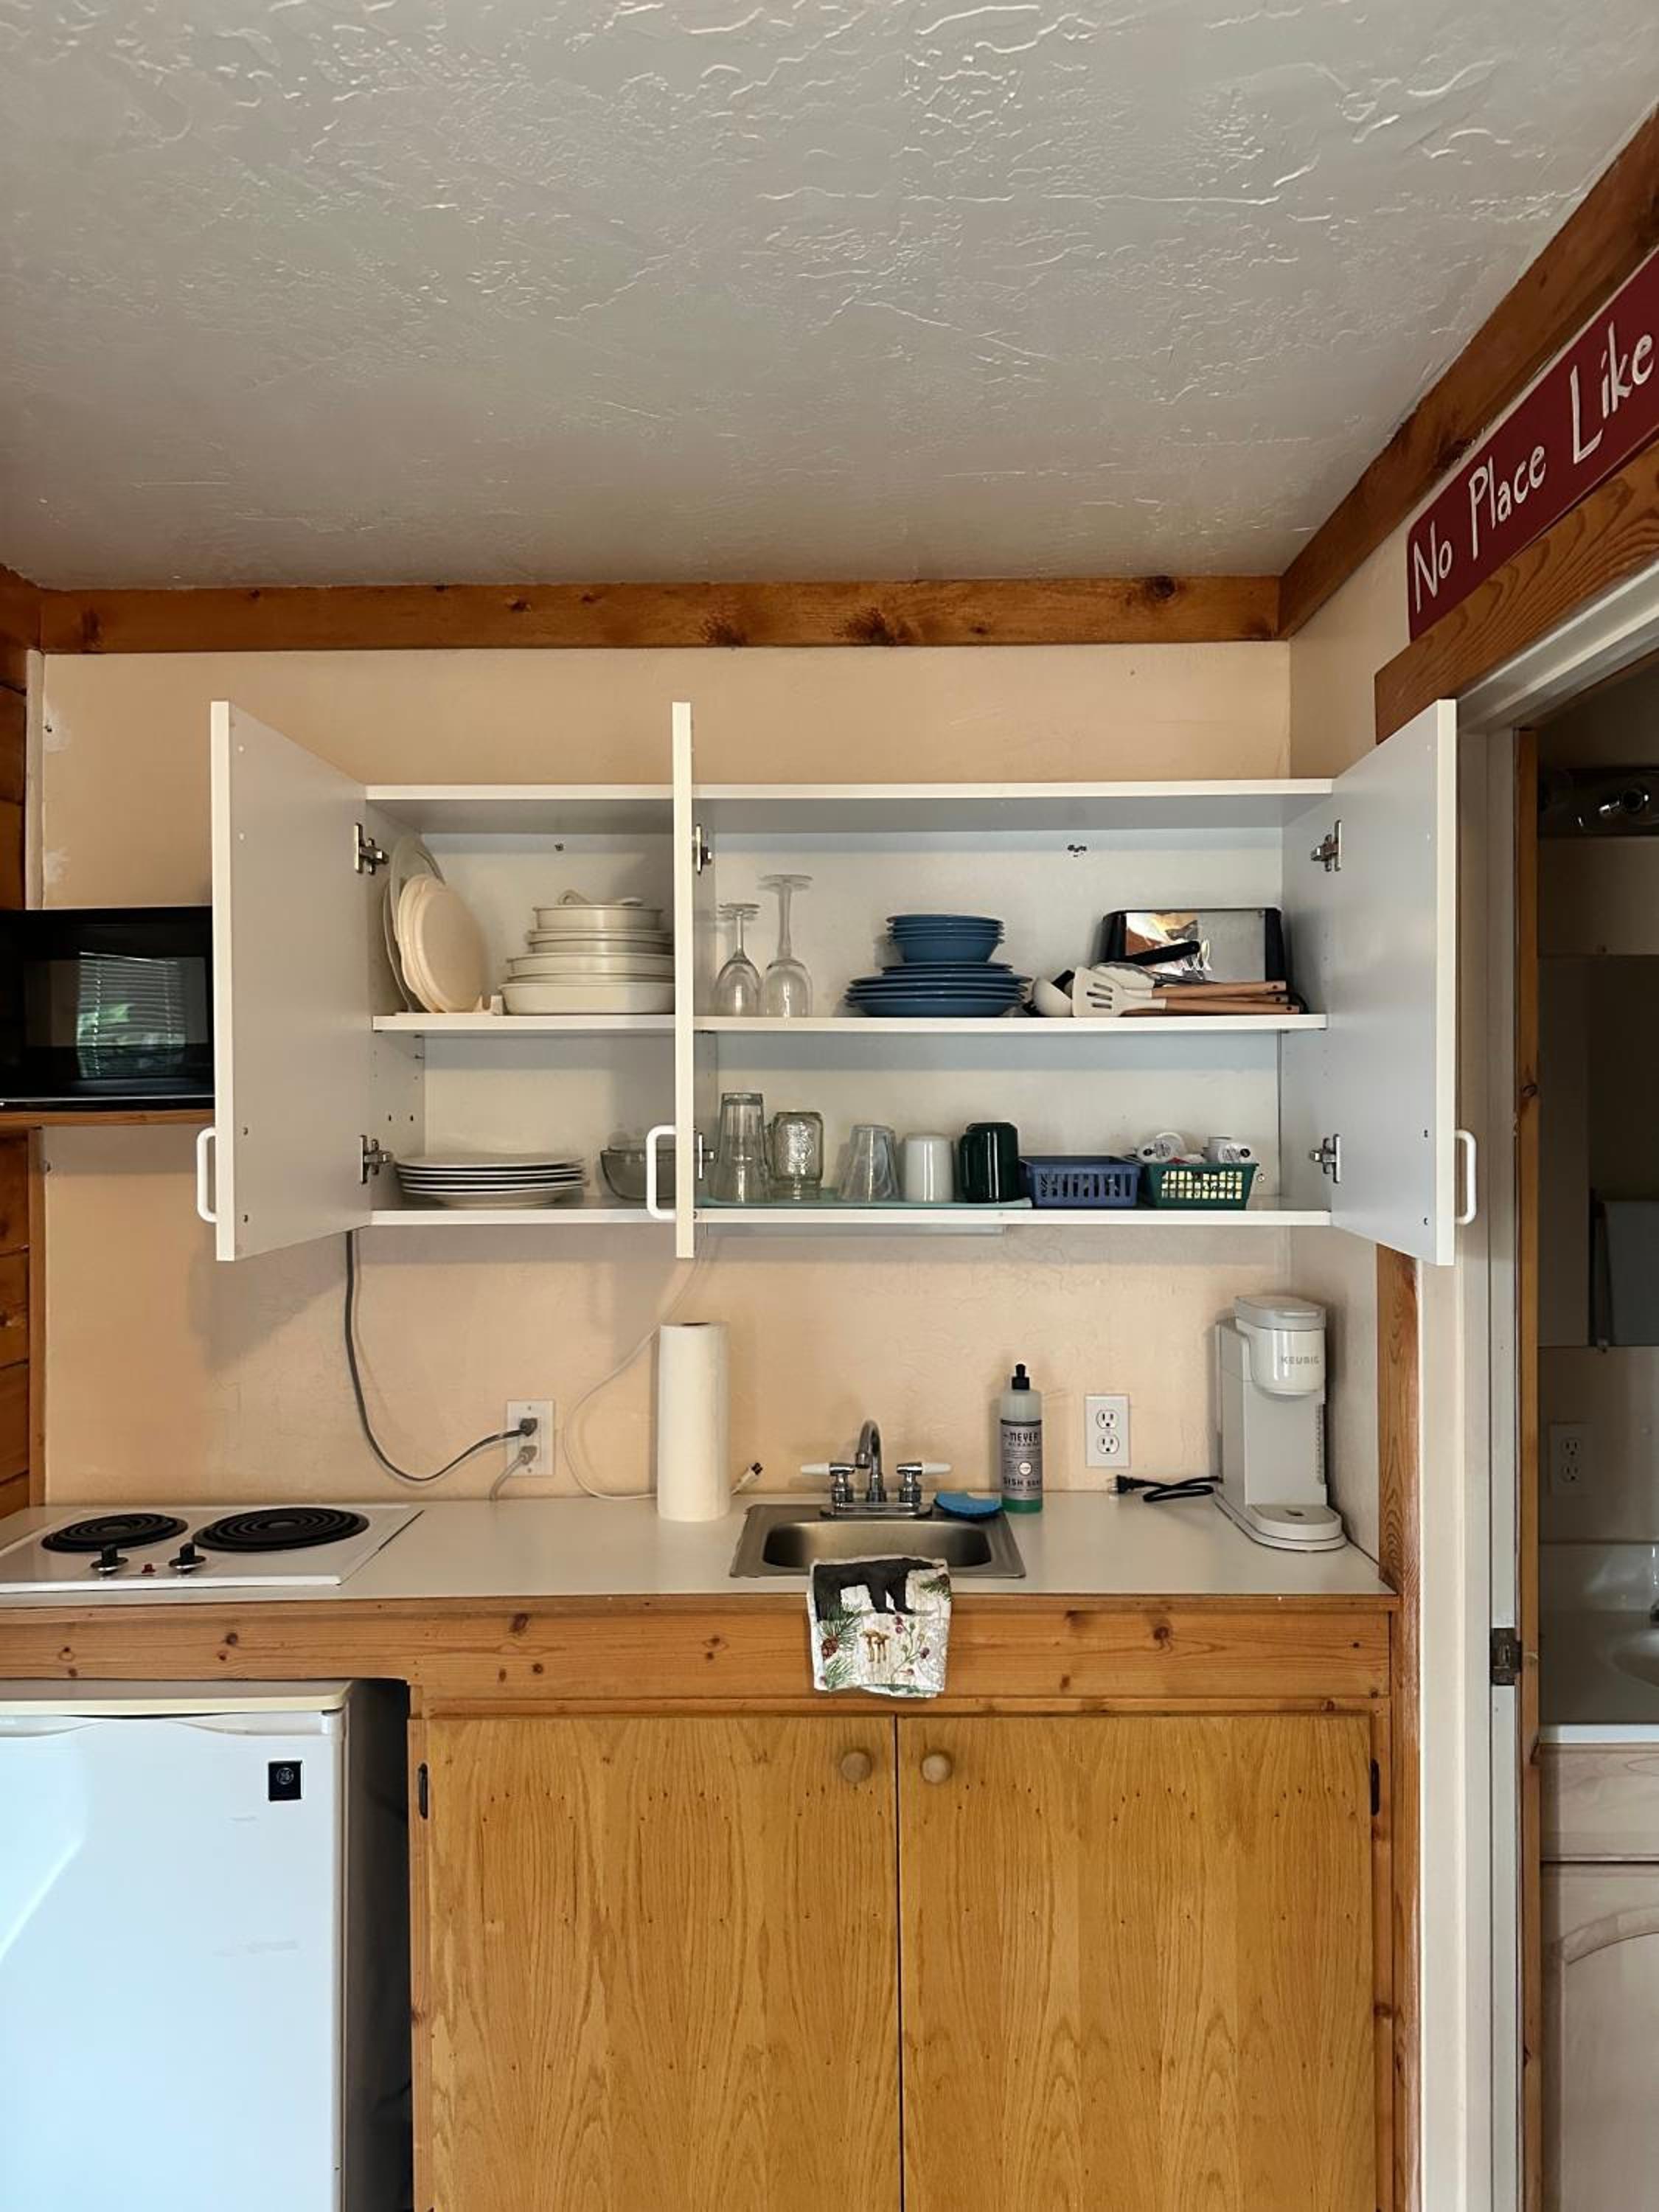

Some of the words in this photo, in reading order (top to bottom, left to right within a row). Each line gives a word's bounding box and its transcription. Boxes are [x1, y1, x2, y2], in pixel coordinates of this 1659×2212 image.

[1413, 521, 1452, 613] No
[1468, 446, 1545, 560] Place
[1570, 320, 1654, 465] Like
[1280, 1356, 1320, 1365] KEURIG
